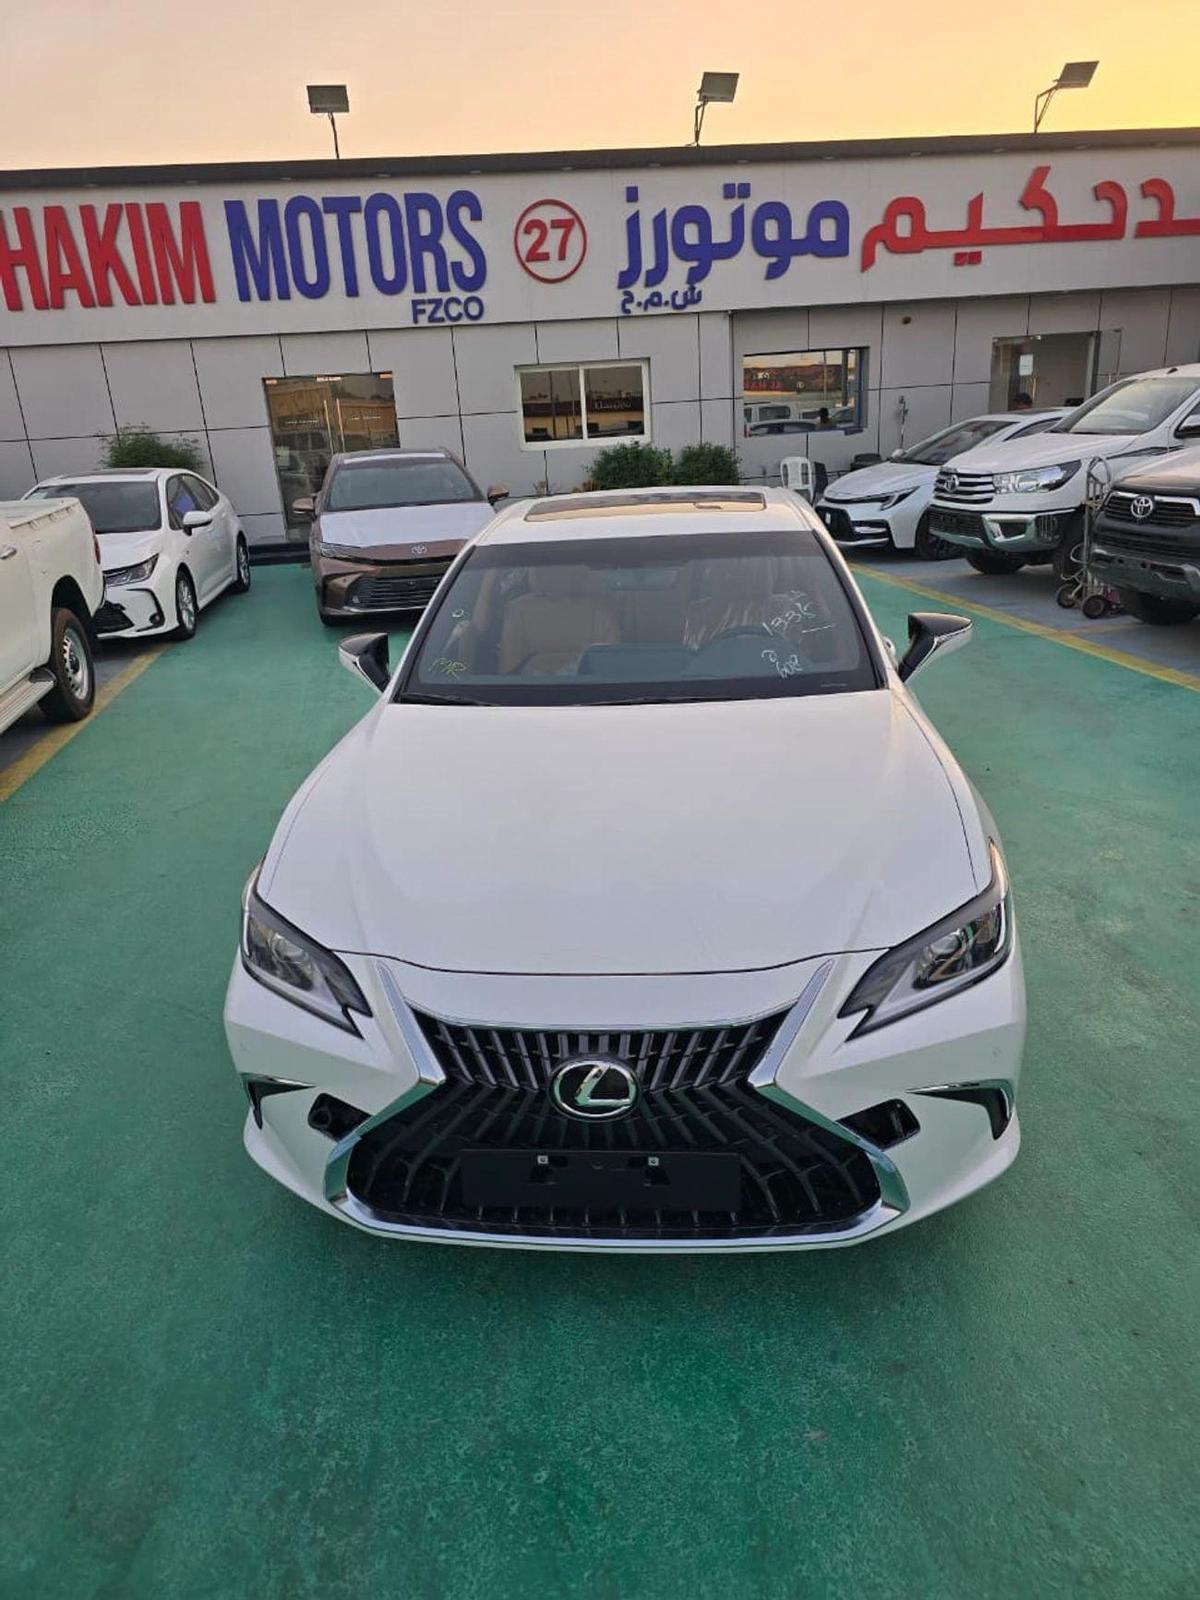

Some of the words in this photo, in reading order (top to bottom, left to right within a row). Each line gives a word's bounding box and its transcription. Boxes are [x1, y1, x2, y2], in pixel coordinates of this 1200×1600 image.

[0, 201, 216, 311] HAKIM
[224, 190, 487, 302] MOTORS
[523, 218, 575, 262] 27
[617, 182, 850, 290] موتورز
[411, 296, 484, 324] FZCO
